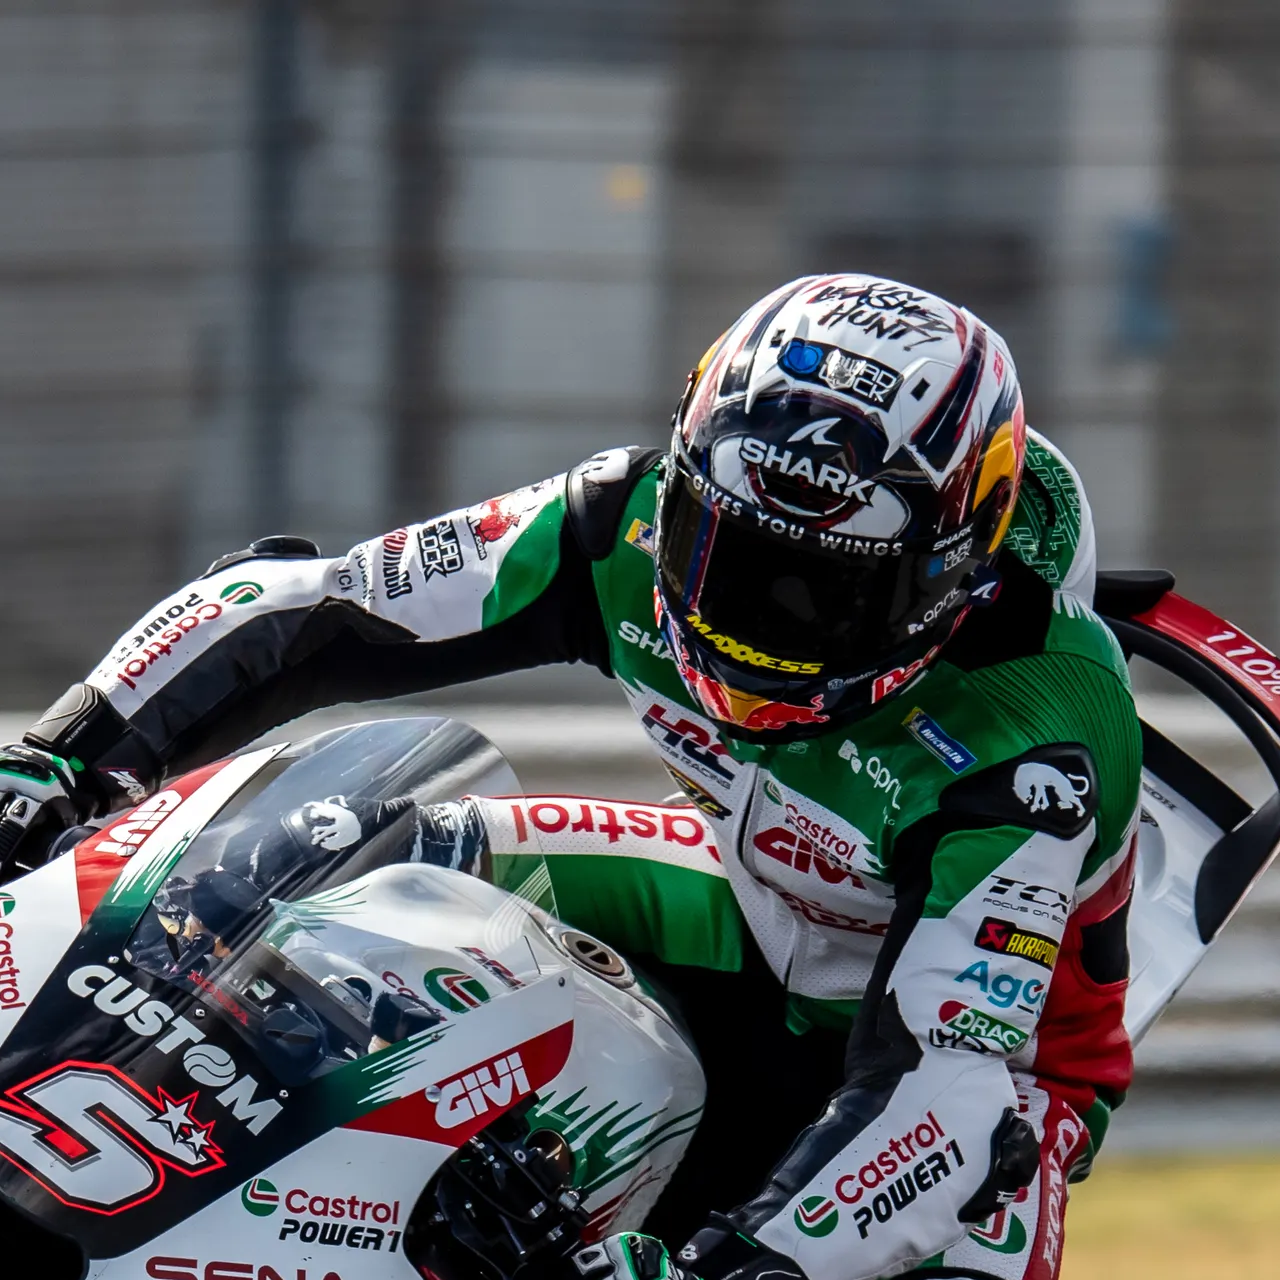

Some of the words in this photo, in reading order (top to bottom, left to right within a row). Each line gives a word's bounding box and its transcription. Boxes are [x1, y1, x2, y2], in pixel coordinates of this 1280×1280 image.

[740, 437, 875, 506] SHARK
[693, 475, 742, 517] GIVES
[756, 512, 805, 541] YOU
[820, 532, 903, 557] WINGS
[932, 522, 975, 551] SHARK
[117, 602, 223, 691] Castrol
[618, 620, 677, 662] SHA
[686, 614, 824, 675] MAXXESS
[920, 728, 965, 764] MICHELIN
[510, 802, 723, 865] astrol
[785, 802, 858, 861] Castrol
[982, 897, 1029, 913] FOCUS
[187, 968, 250, 1026] HONDA
[67, 965, 284, 1136] CUSTOM
[434, 1051, 532, 1130] GIVI
[835, 1110, 946, 1205] Castrol
[284, 1187, 400, 1226] Castrol
[852, 1138, 966, 1240] POWER1
[278, 1218, 401, 1253] POWER1
